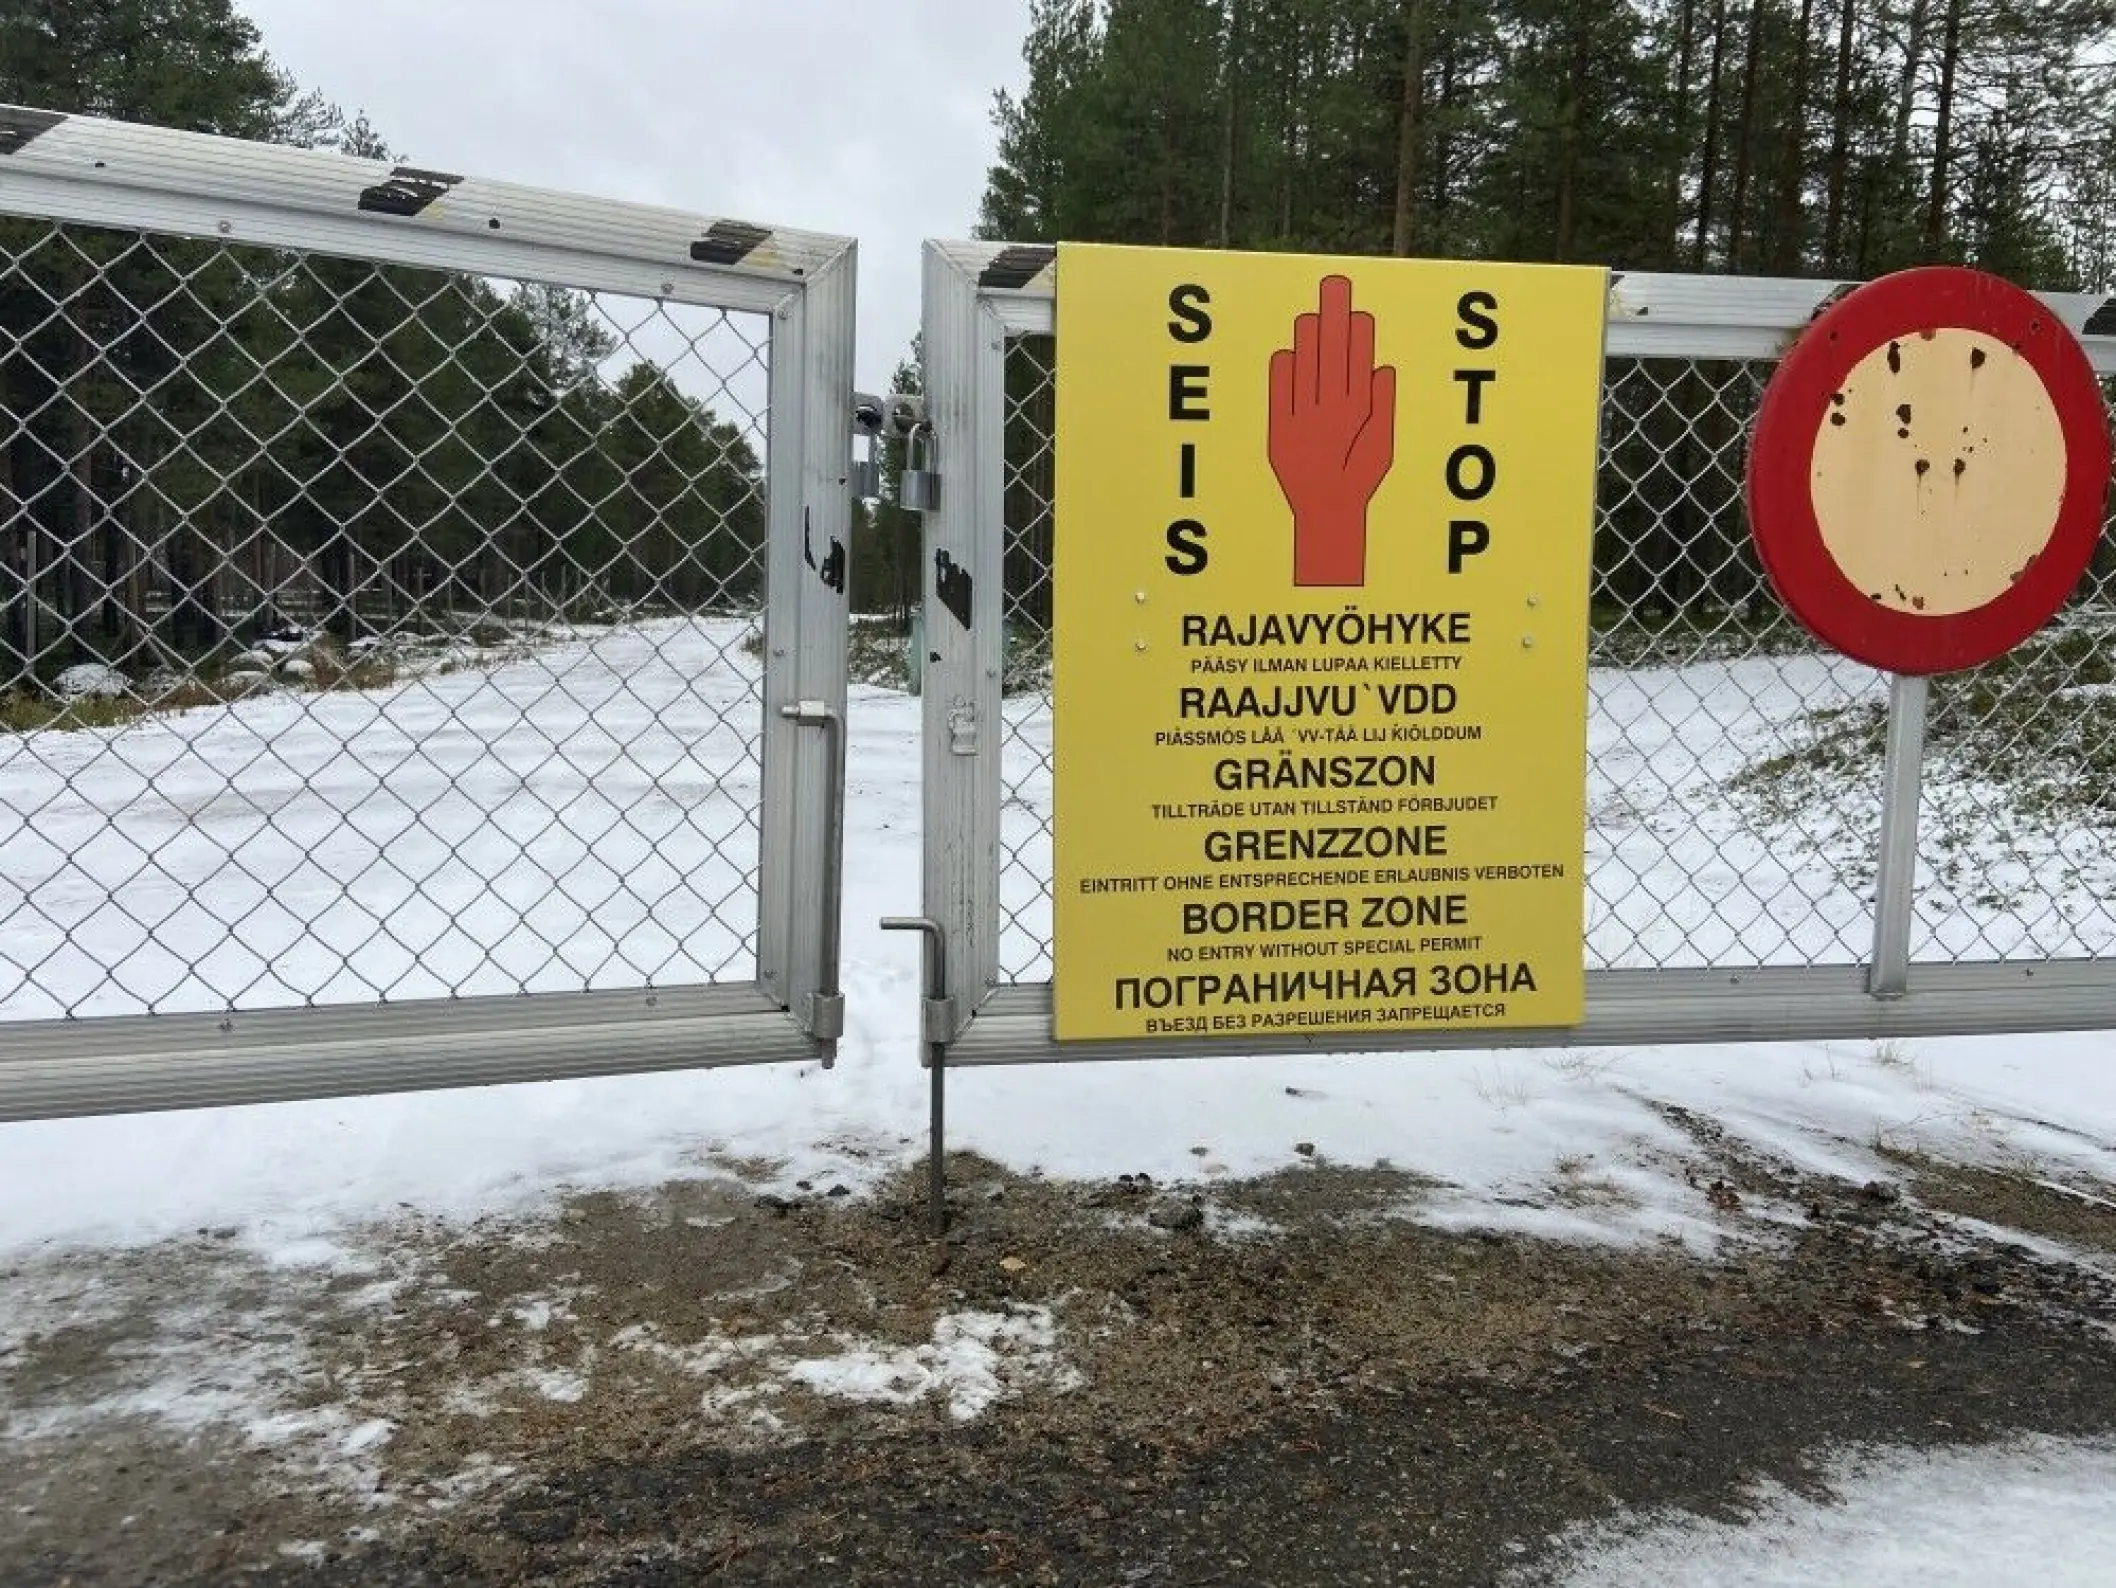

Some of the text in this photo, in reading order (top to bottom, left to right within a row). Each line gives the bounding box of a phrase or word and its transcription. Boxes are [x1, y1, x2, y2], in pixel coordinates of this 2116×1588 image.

[1165, 284, 1212, 576] SEIS
[1445, 290, 1498, 574] STOP
[1182, 605, 1471, 647] RAJAVYÖHYKE
[1191, 655, 1463, 674] PÄÄSY ILMAN LUPAA KIELLETTY
[1214, 749, 1435, 791] GRÄNSZON
[1151, 799, 1245, 819] TILLTRÄDE
[1249, 801, 1297, 817] UTAN
[1397, 794, 1498, 814] FÖRBJUDET
[1204, 825, 1448, 862] GRENZZONE
[1080, 863, 1564, 894] EINTRITT OHNE ENTSPRECHENDE ERLAUBNIS VERBOTEN
[1183, 894, 1468, 935] BORDER ZONE
[1166, 935, 1484, 963] NO ENTRY WITHOUT SPECIAL PERMIT
[1115, 961, 1538, 1011] ПОГРАНИЧНАЯ ЗОНА
[1146, 1003, 1507, 1034] ВЪЕЗД БЕЗ РАЗРЕШЕНИЯ ЗАПРЕЩАЕТСЯ
